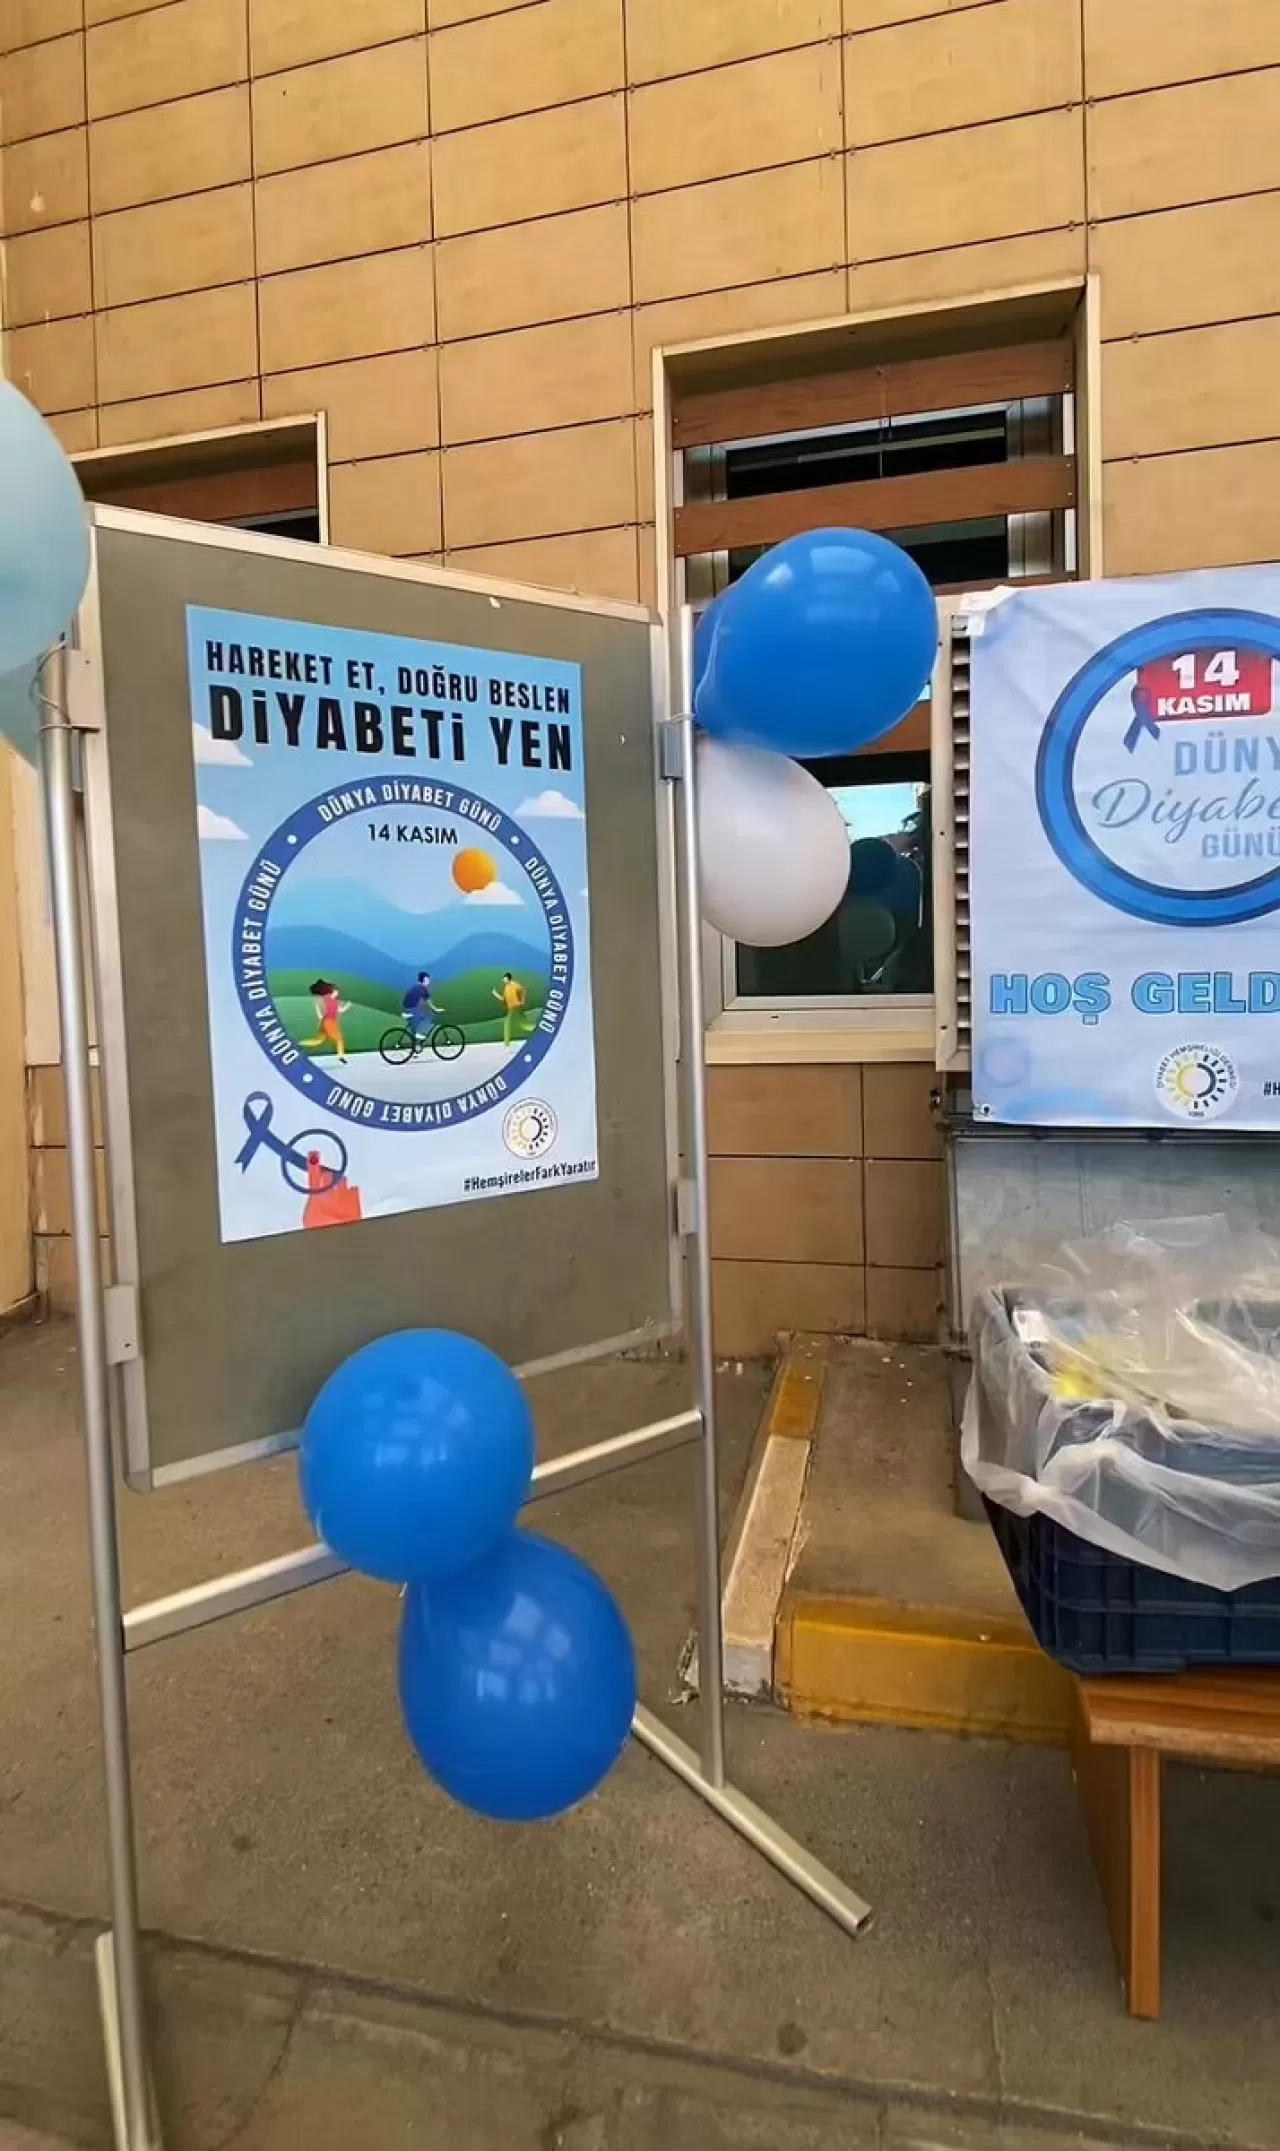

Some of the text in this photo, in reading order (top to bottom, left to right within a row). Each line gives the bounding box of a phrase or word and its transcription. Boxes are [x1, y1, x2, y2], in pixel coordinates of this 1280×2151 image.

[206, 640, 570, 714] HAREKET ET, DOĞRU BESLEN
[1172, 650, 1240, 689] 14
[209, 684, 572, 771] DİYABETİ YEN
[1157, 692, 1251, 717] KASIM
[317, 779, 502, 832] DÜNYA DİYABET GÜNÜ
[368, 824, 458, 845] 14 KASIM
[241, 859, 299, 1066] DÜNYA DİYABET GÜNÜ
[990, 971, 1112, 1026] HOŞ
